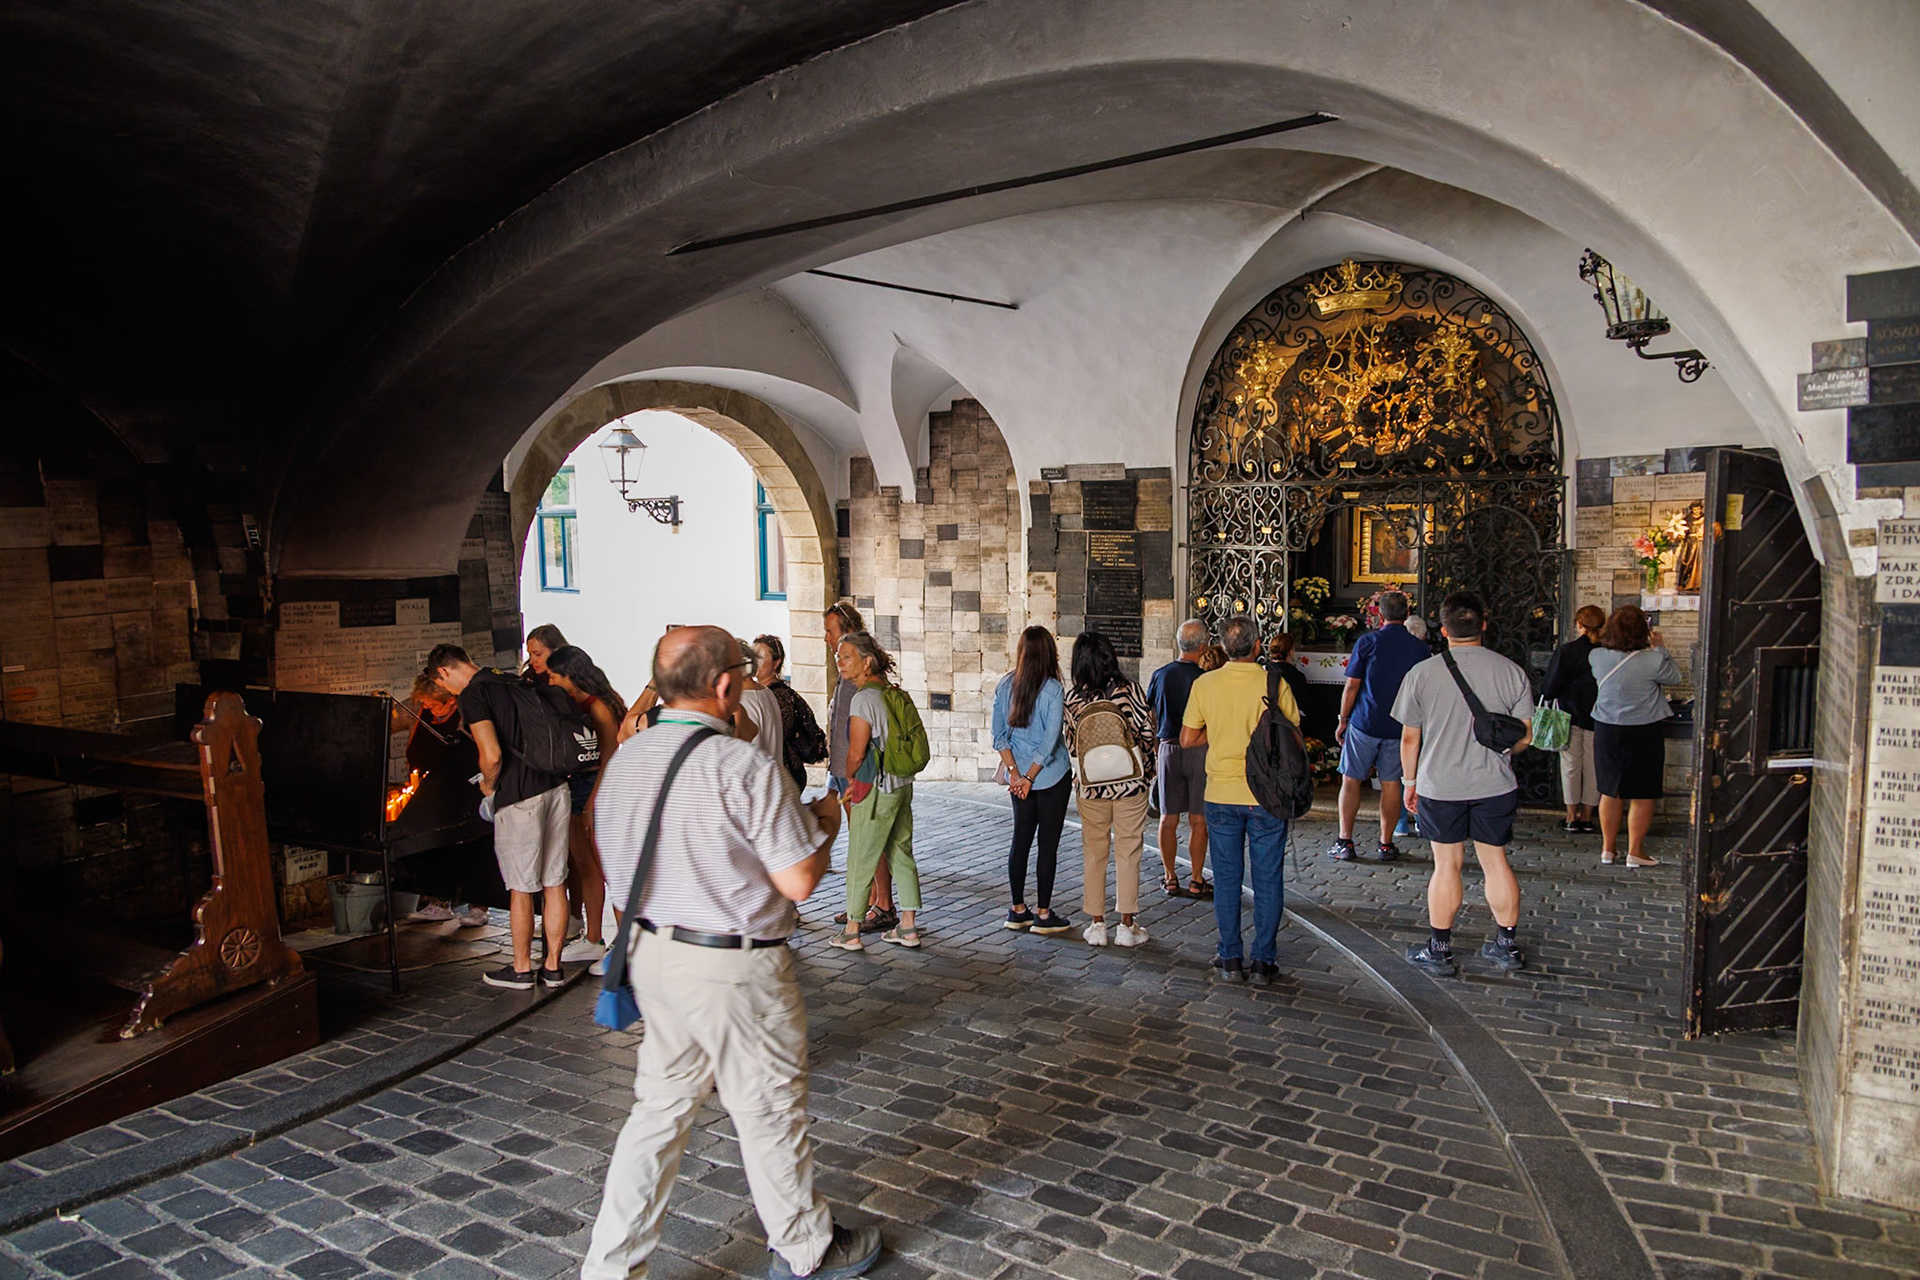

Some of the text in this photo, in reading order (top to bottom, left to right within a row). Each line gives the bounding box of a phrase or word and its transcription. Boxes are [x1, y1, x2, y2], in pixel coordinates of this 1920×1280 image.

[1884, 536, 1897, 545] TI
[1882, 674, 1908, 684] HVALA
[1877, 685, 1887, 695] NA
[1880, 728, 1907, 738] MAJKO
[1881, 770, 1907, 781] HVALA
[1882, 793, 1906, 803] DALJE
[1880, 816, 1907, 826] MAJKO
[1876, 827, 1886, 835] NA
[1875, 836, 1895, 847] PRED
[1900, 839, 1910, 848] SE
[1877, 864, 1917, 876] HVALA TI
[1866, 900, 1891, 912] HVALA
[1898, 904, 1905, 913] TI
[1866, 922, 1876, 930] ZA
[1862, 954, 1888, 964] HVALA
[1894, 957, 1901, 966] TI
[1861, 974, 1884, 985] DALJE
[1866, 1000, 1892, 1010] HVALA
[1898, 1003, 1905, 1013] TI
